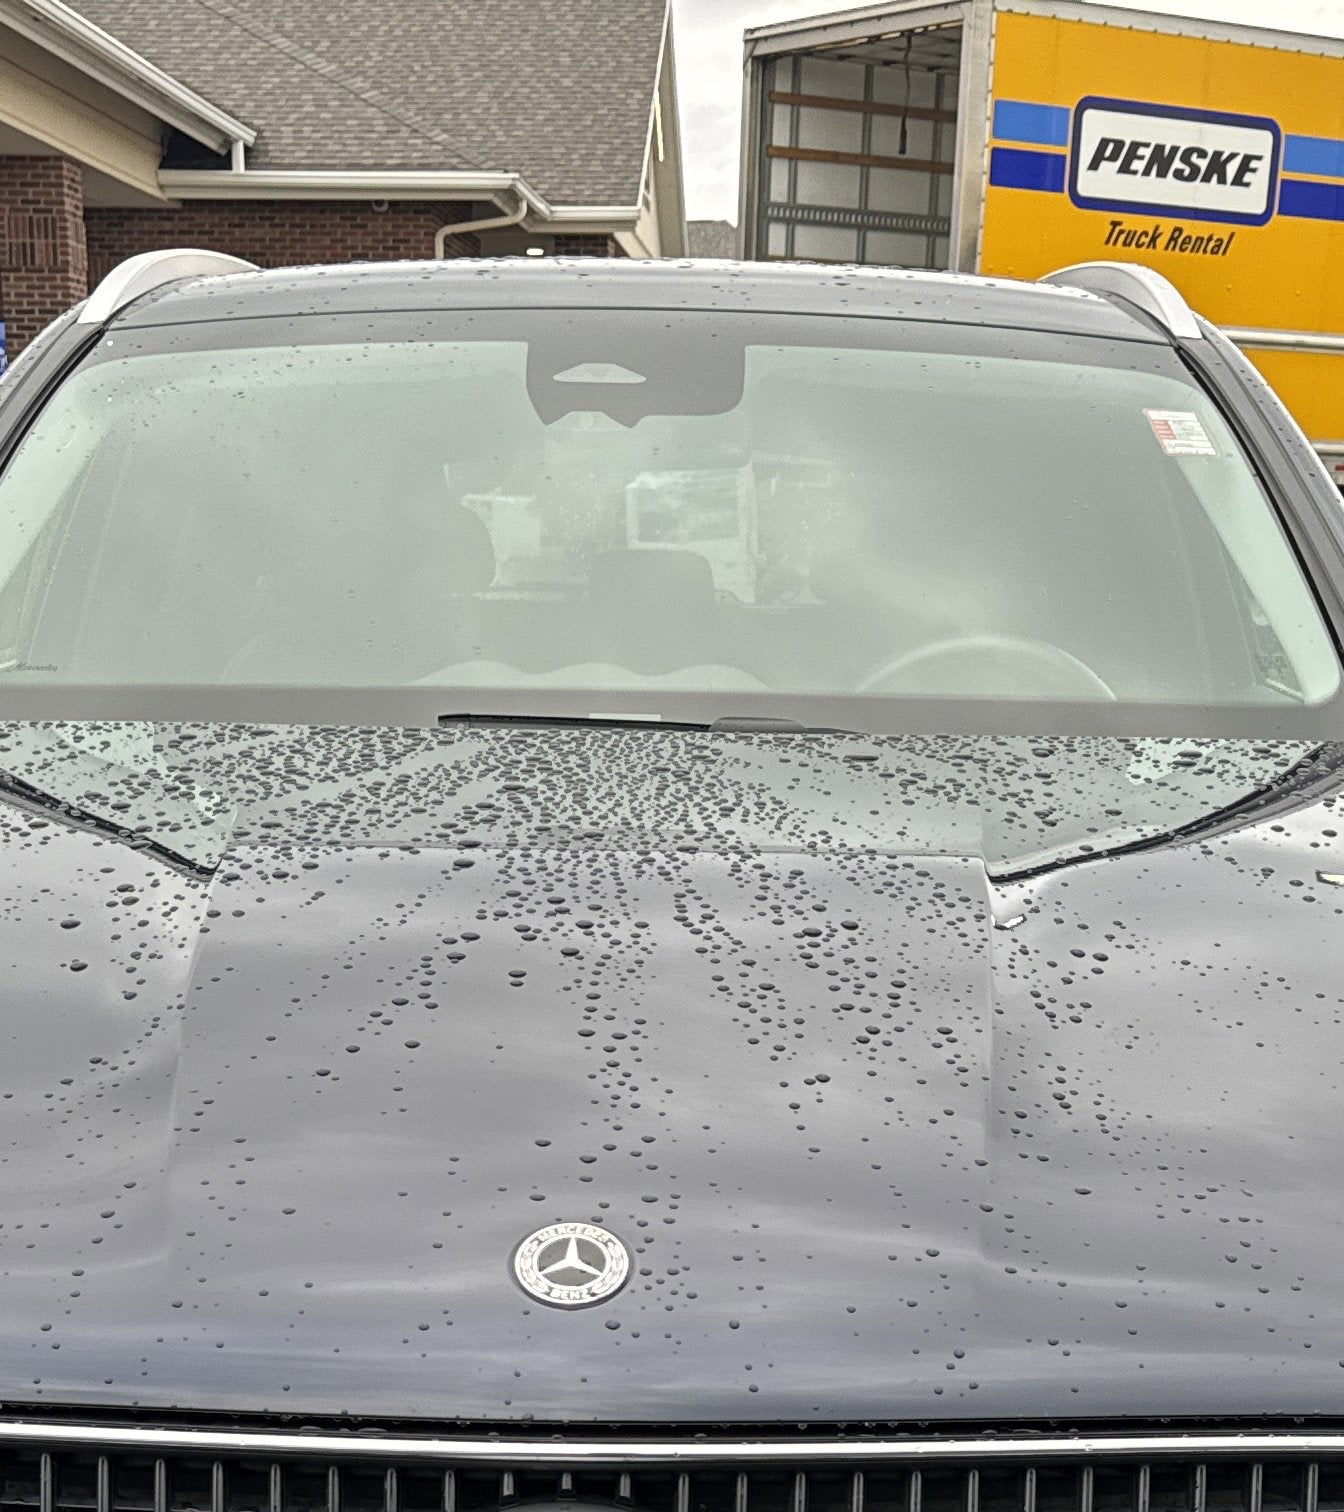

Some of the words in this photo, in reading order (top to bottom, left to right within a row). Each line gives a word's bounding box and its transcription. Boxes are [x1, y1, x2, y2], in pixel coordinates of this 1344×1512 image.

[1086, 136, 1265, 188] PENSKE
[1104, 220, 1164, 250] Truck
[1163, 225, 1236, 257] Rental
